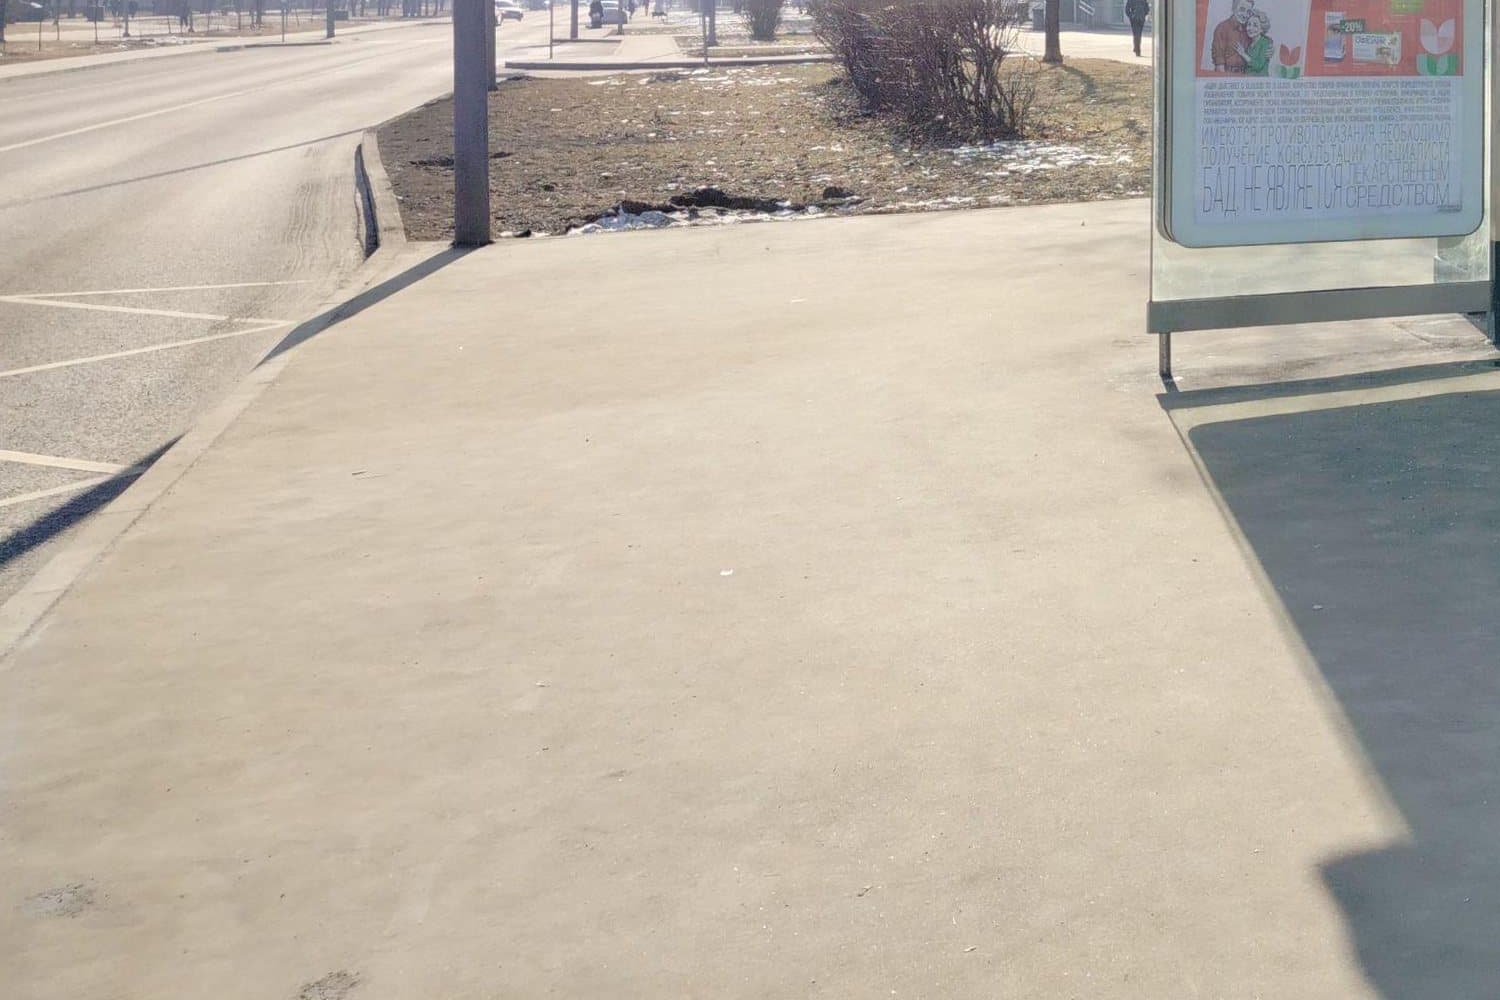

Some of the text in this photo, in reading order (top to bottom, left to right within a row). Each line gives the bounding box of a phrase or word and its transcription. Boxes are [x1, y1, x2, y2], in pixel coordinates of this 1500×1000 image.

[1201, 141, 1450, 166] ПОЛУЧЕНИЕ КОНСУЛЬТАЦИИ СПЕЦИАЛИСТА
[1266, 163, 1343, 211] ЯВЛЯЕТСЯ
